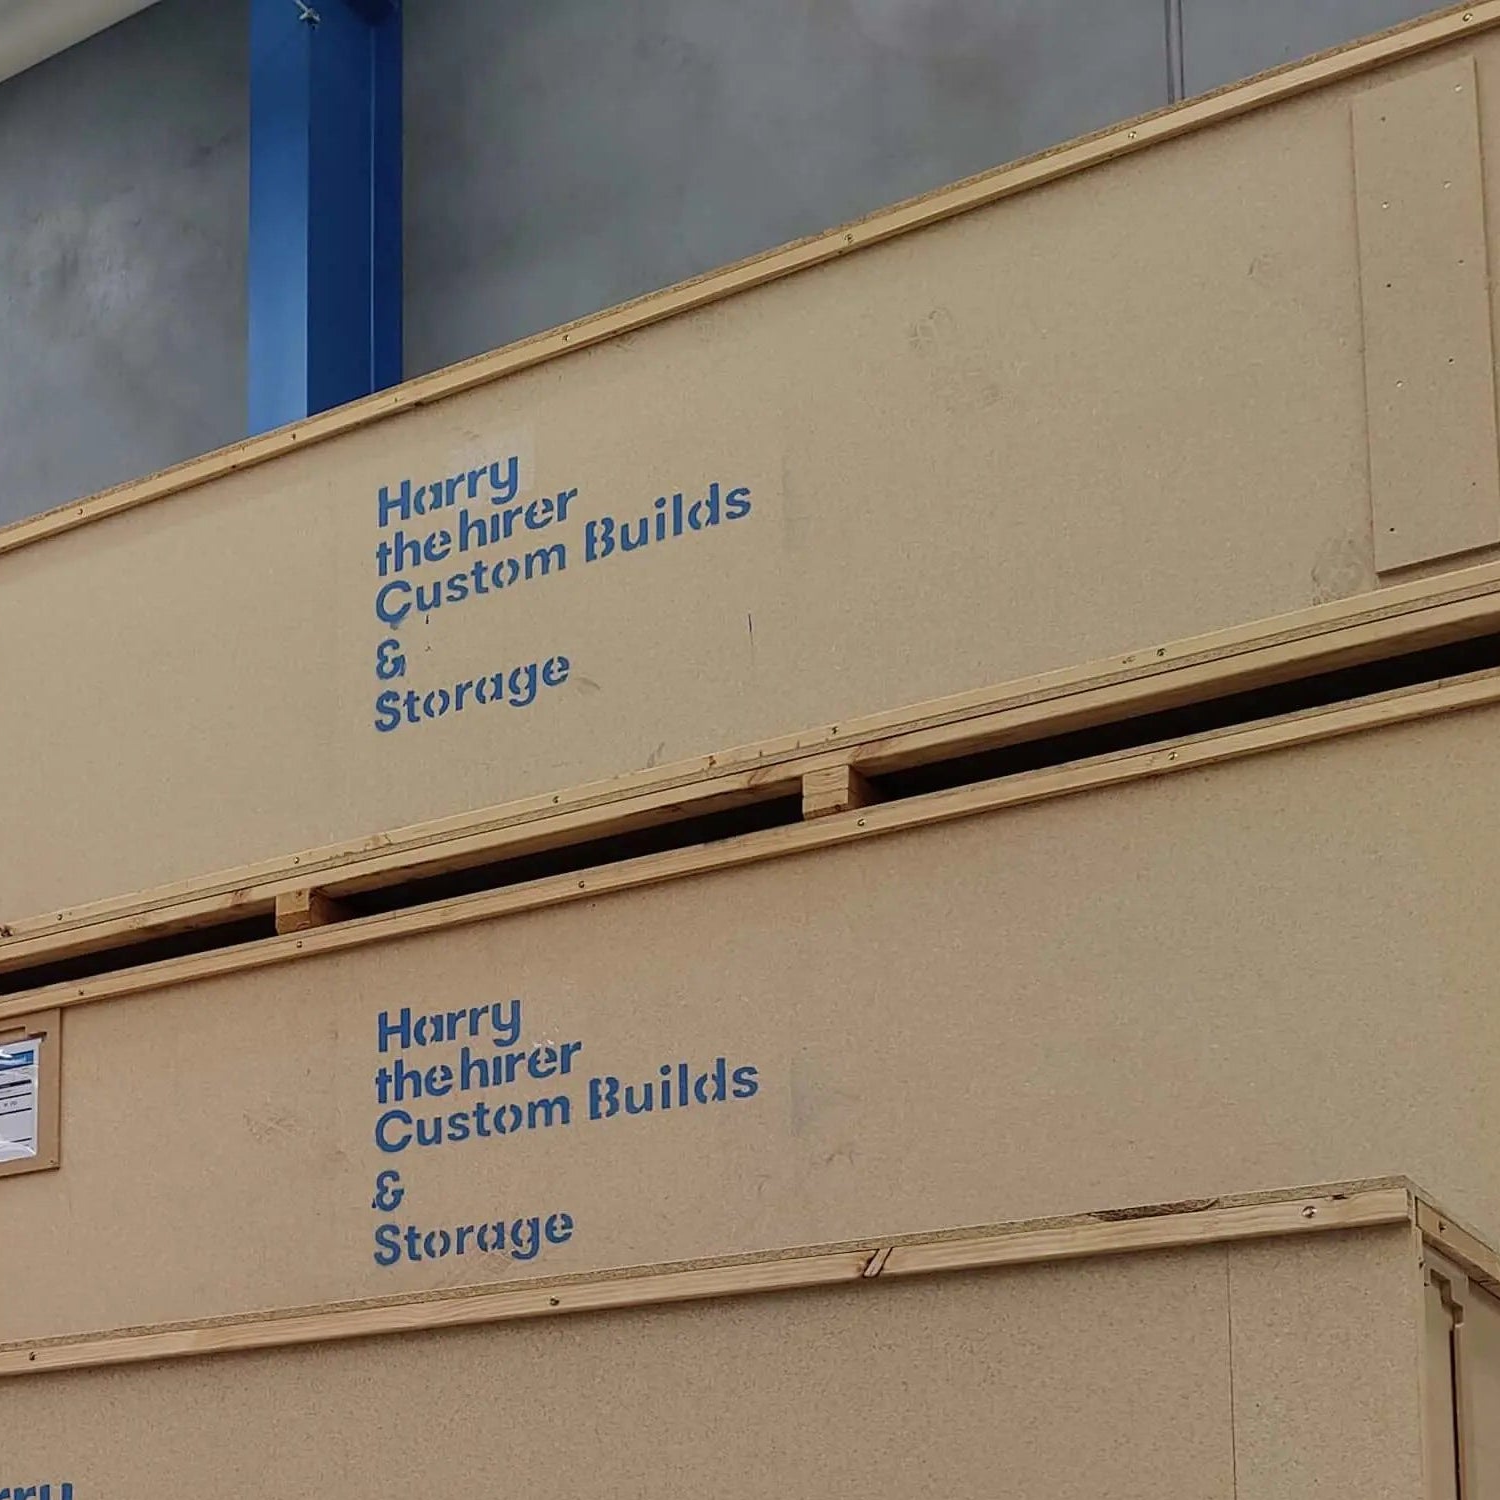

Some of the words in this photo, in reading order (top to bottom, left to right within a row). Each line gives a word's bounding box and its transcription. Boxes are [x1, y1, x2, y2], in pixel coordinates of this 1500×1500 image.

[379, 457, 518, 527] Harry
[376, 544, 565, 625] Custom
[586, 483, 750, 560] Builds
[376, 640, 405, 679] &
[376, 657, 568, 731] Storage
[379, 1002, 520, 1051] Harry
[376, 1097, 569, 1152] Custom
[589, 1060, 757, 1120] Builds
[374, 1171, 403, 1211] &
[376, 1216, 572, 1264] Storage
